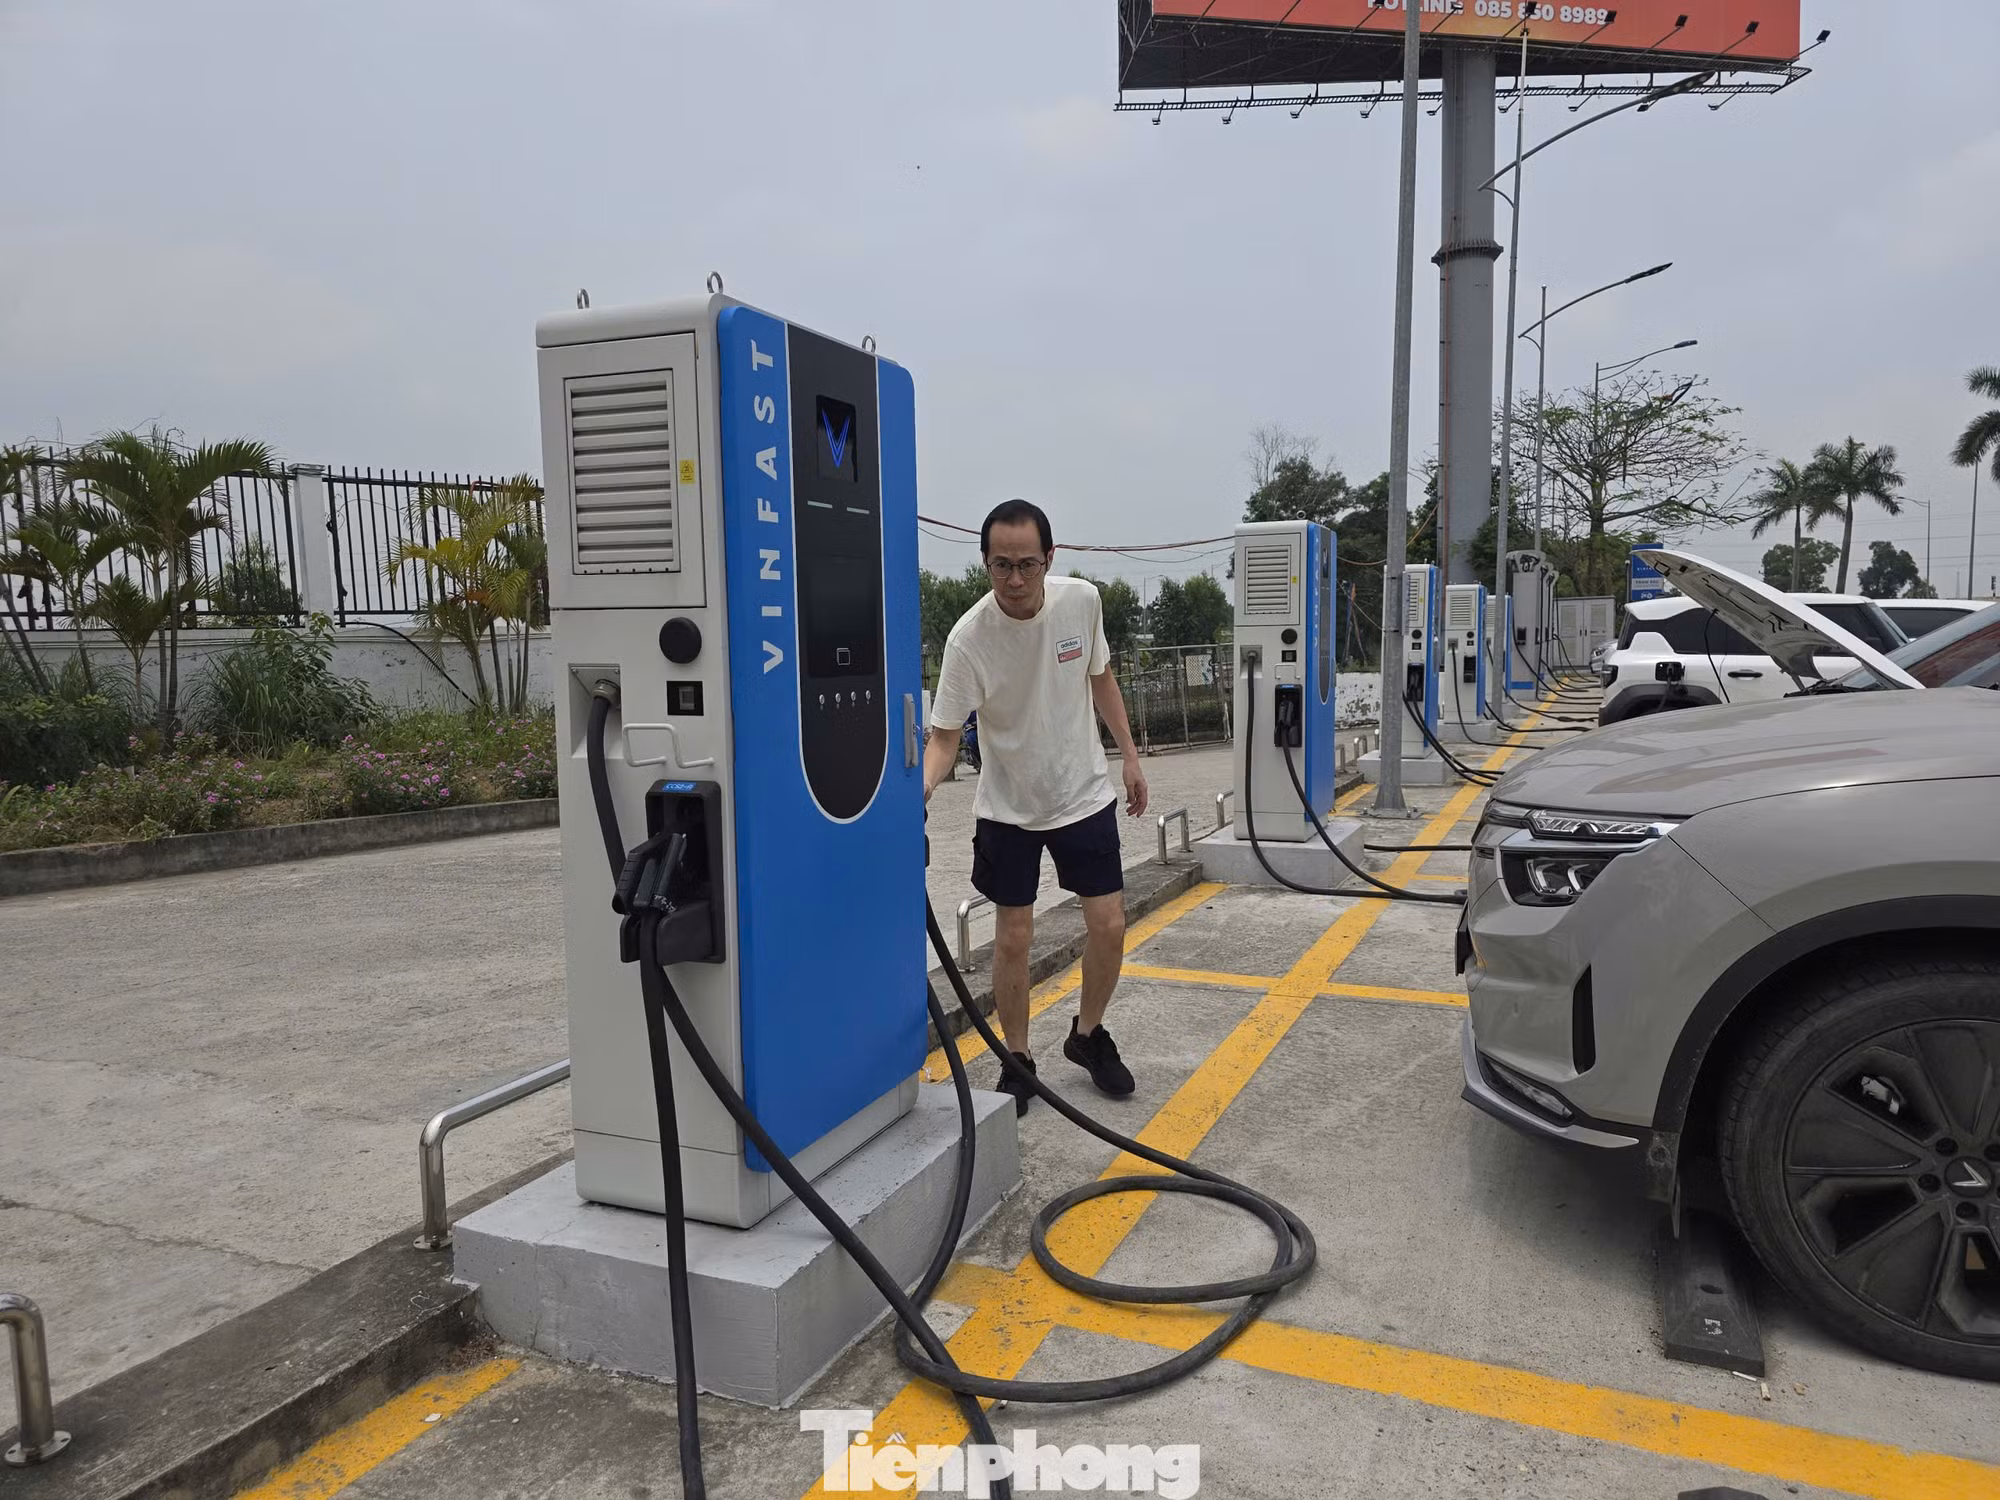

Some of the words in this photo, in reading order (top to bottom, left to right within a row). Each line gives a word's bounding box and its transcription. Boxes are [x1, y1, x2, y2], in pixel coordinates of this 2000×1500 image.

[1474, 0, 1512, 18] 085
[1559, 5, 1609, 25] 8989
[751, 339, 784, 674] VINFAST
